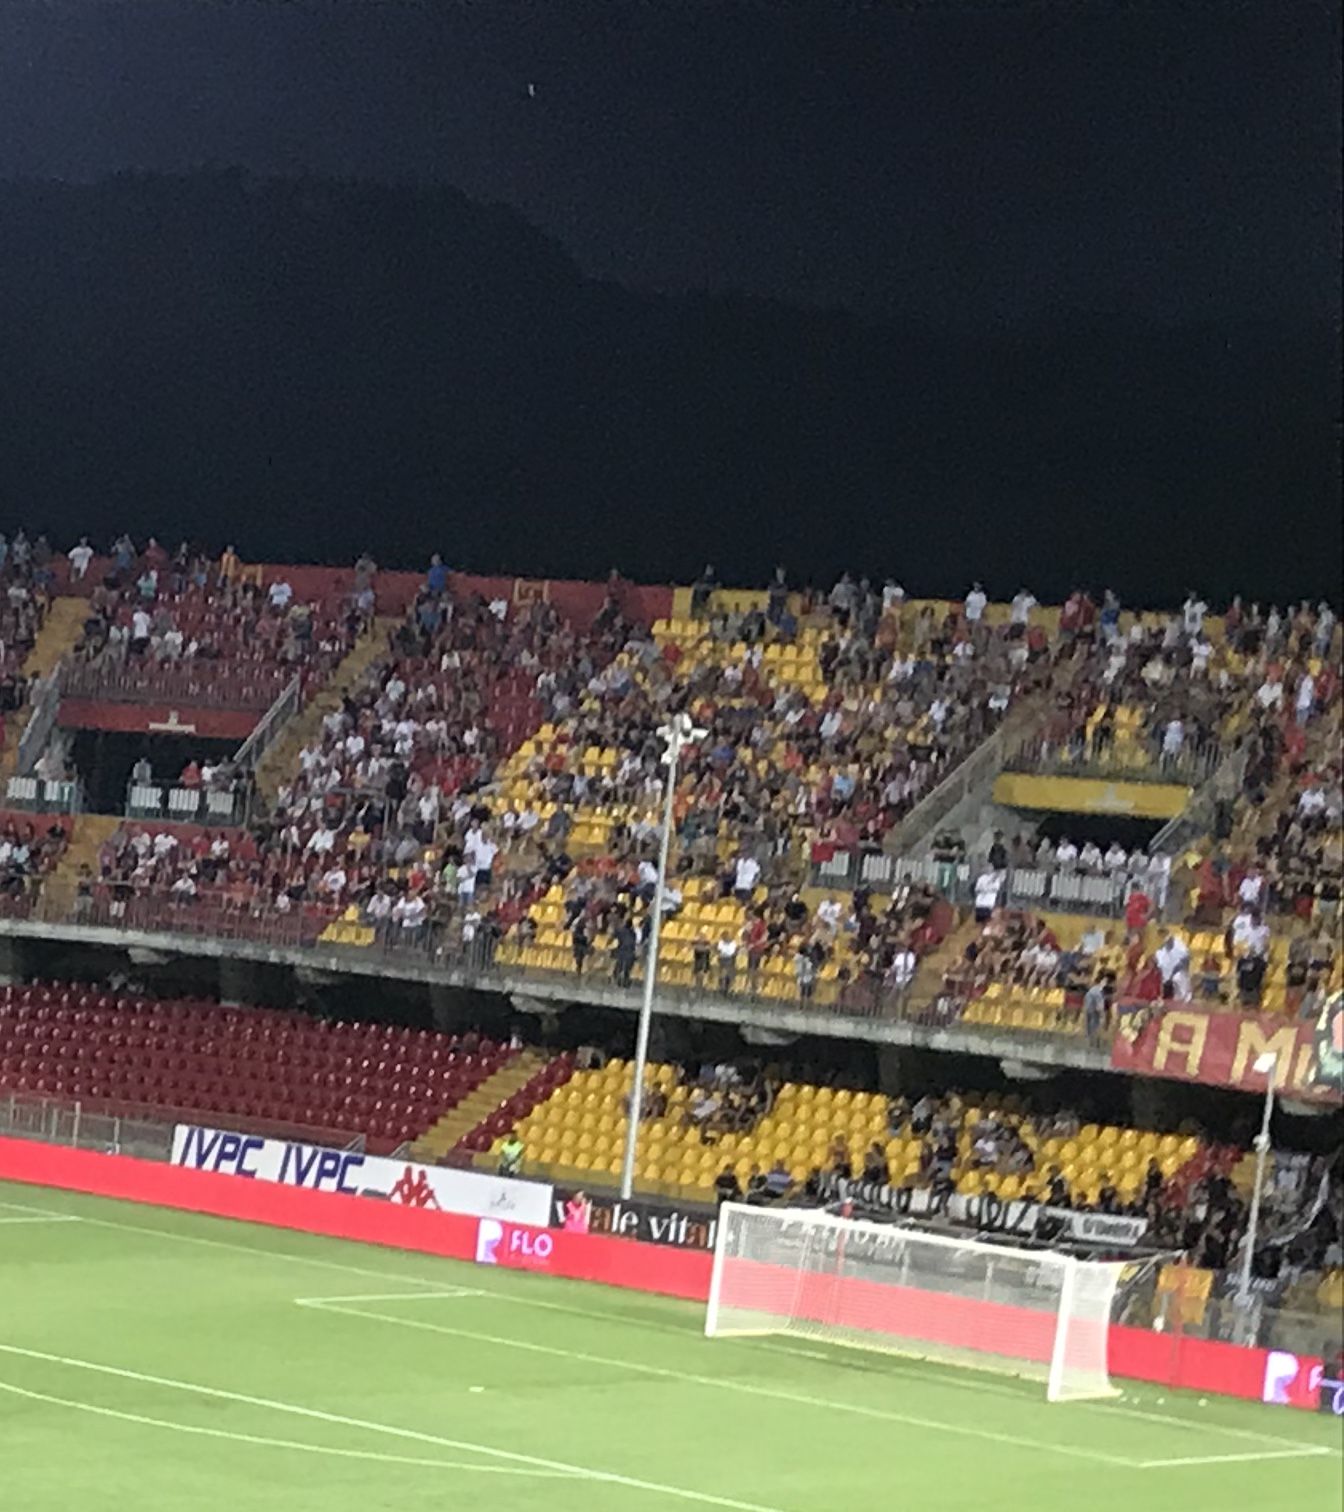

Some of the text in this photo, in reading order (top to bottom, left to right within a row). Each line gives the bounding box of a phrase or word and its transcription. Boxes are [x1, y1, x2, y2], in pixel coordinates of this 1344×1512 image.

[179, 1126, 366, 1195] IVPC IVPC
[555, 1197, 639, 1235] vtale
[510, 1229, 554, 1258] FLO
